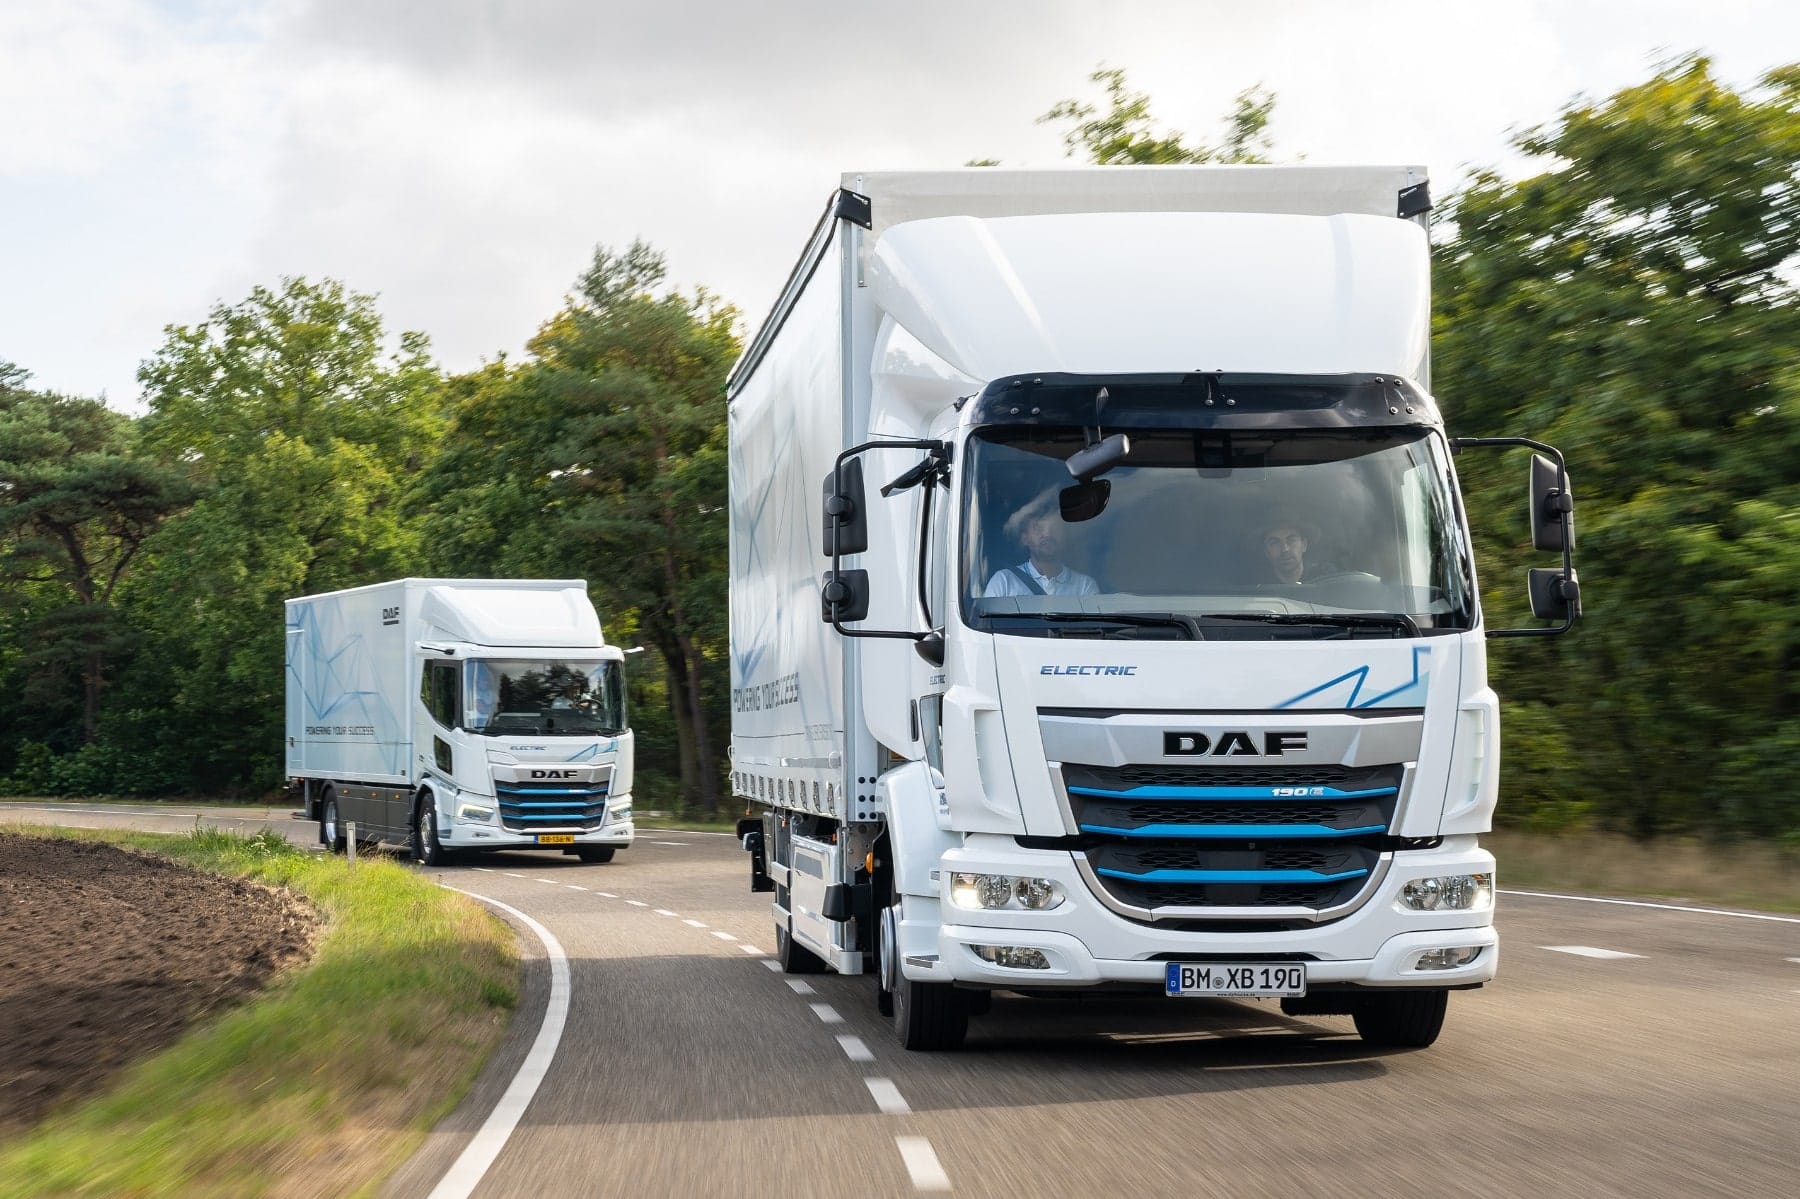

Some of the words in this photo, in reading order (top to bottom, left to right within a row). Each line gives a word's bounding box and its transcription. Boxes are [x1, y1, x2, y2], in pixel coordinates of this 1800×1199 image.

[383, 606, 399, 620] DAF
[1040, 665, 1138, 676] ELECTRIC
[1163, 731, 1309, 757] DAF
[531, 770, 578, 779] DAF
[1272, 787, 1308, 797] 190
[1181, 968, 1211, 989] BM
[1226, 968, 1255, 989] XB
[1260, 968, 1301, 989] 190
